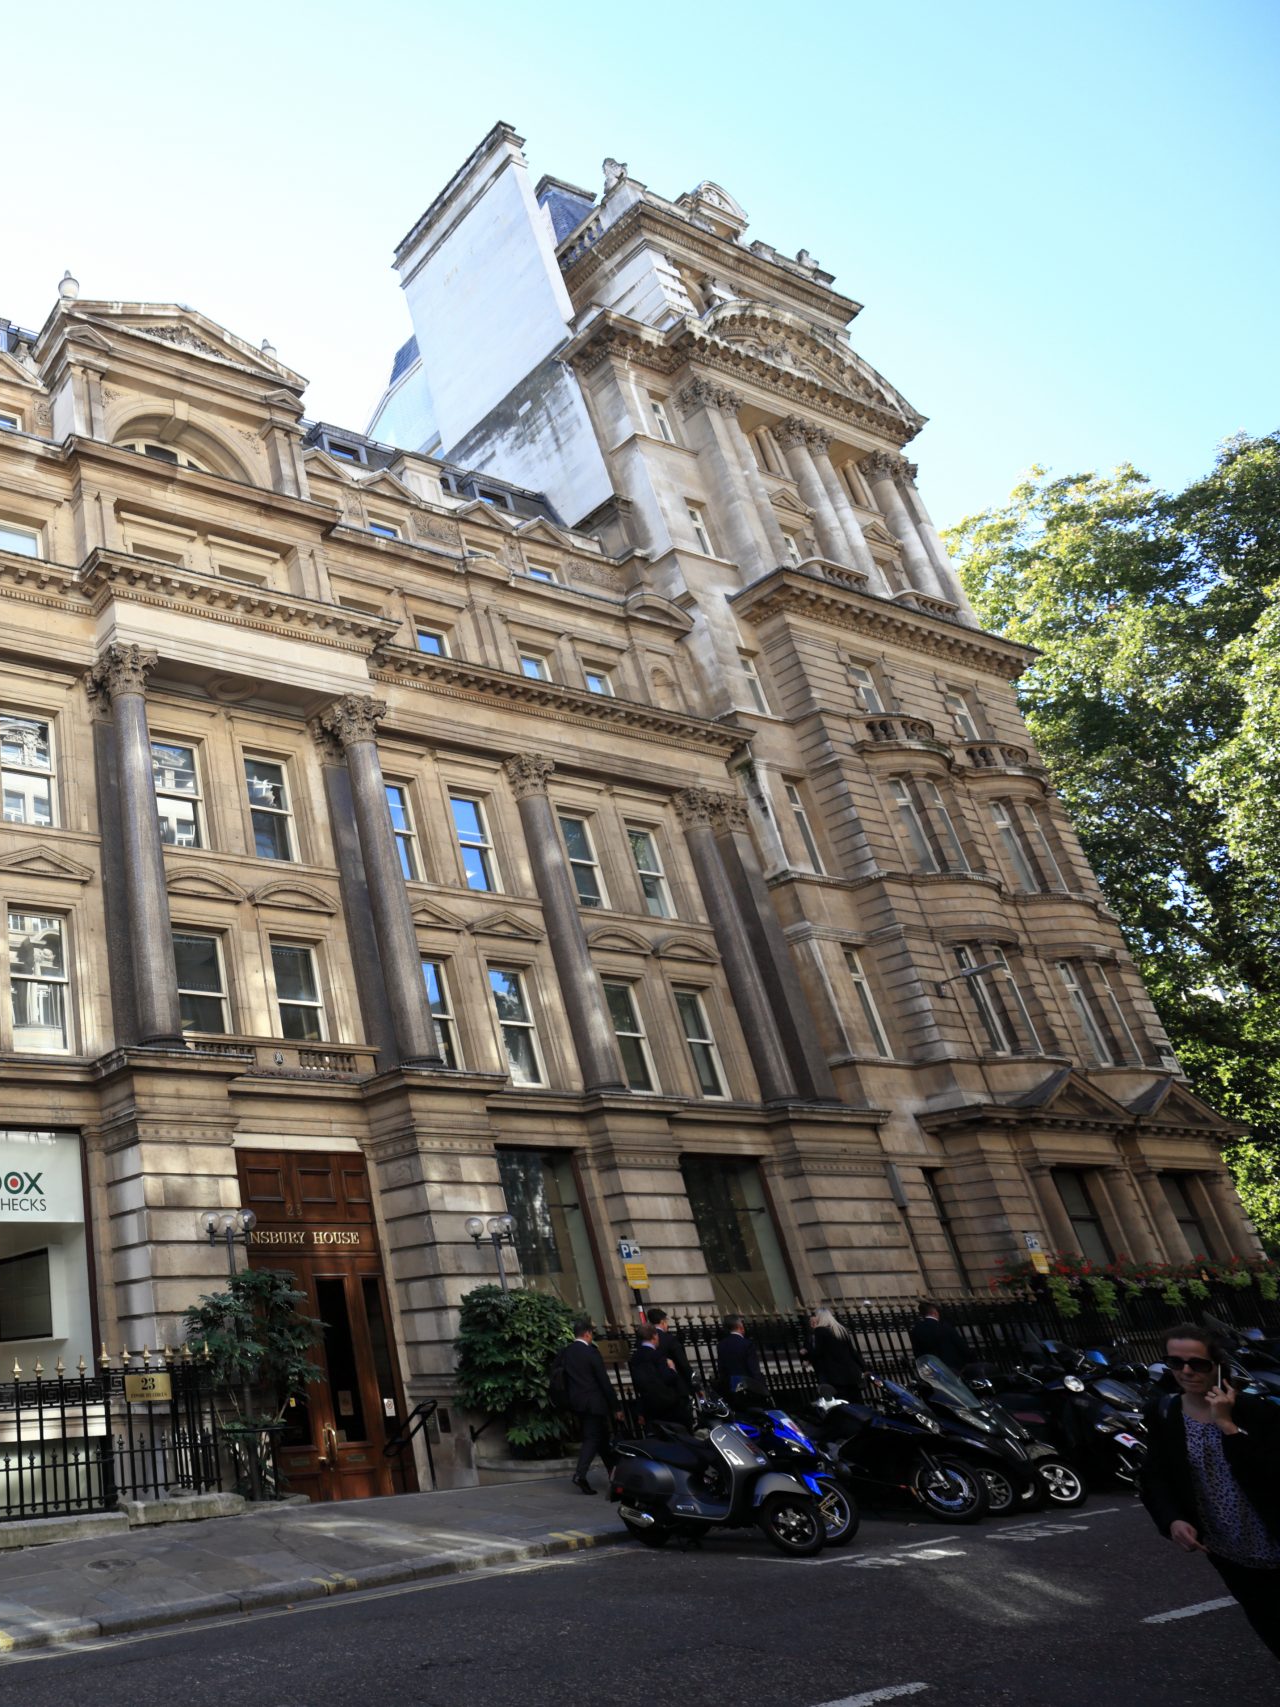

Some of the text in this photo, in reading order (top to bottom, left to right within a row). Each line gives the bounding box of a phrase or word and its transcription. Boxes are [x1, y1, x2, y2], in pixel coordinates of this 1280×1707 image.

[246, 1231, 360, 1244] NSBURY HOUSE
[621, 1244, 630, 1258] P
[141, 1377, 156, 1390] 23
